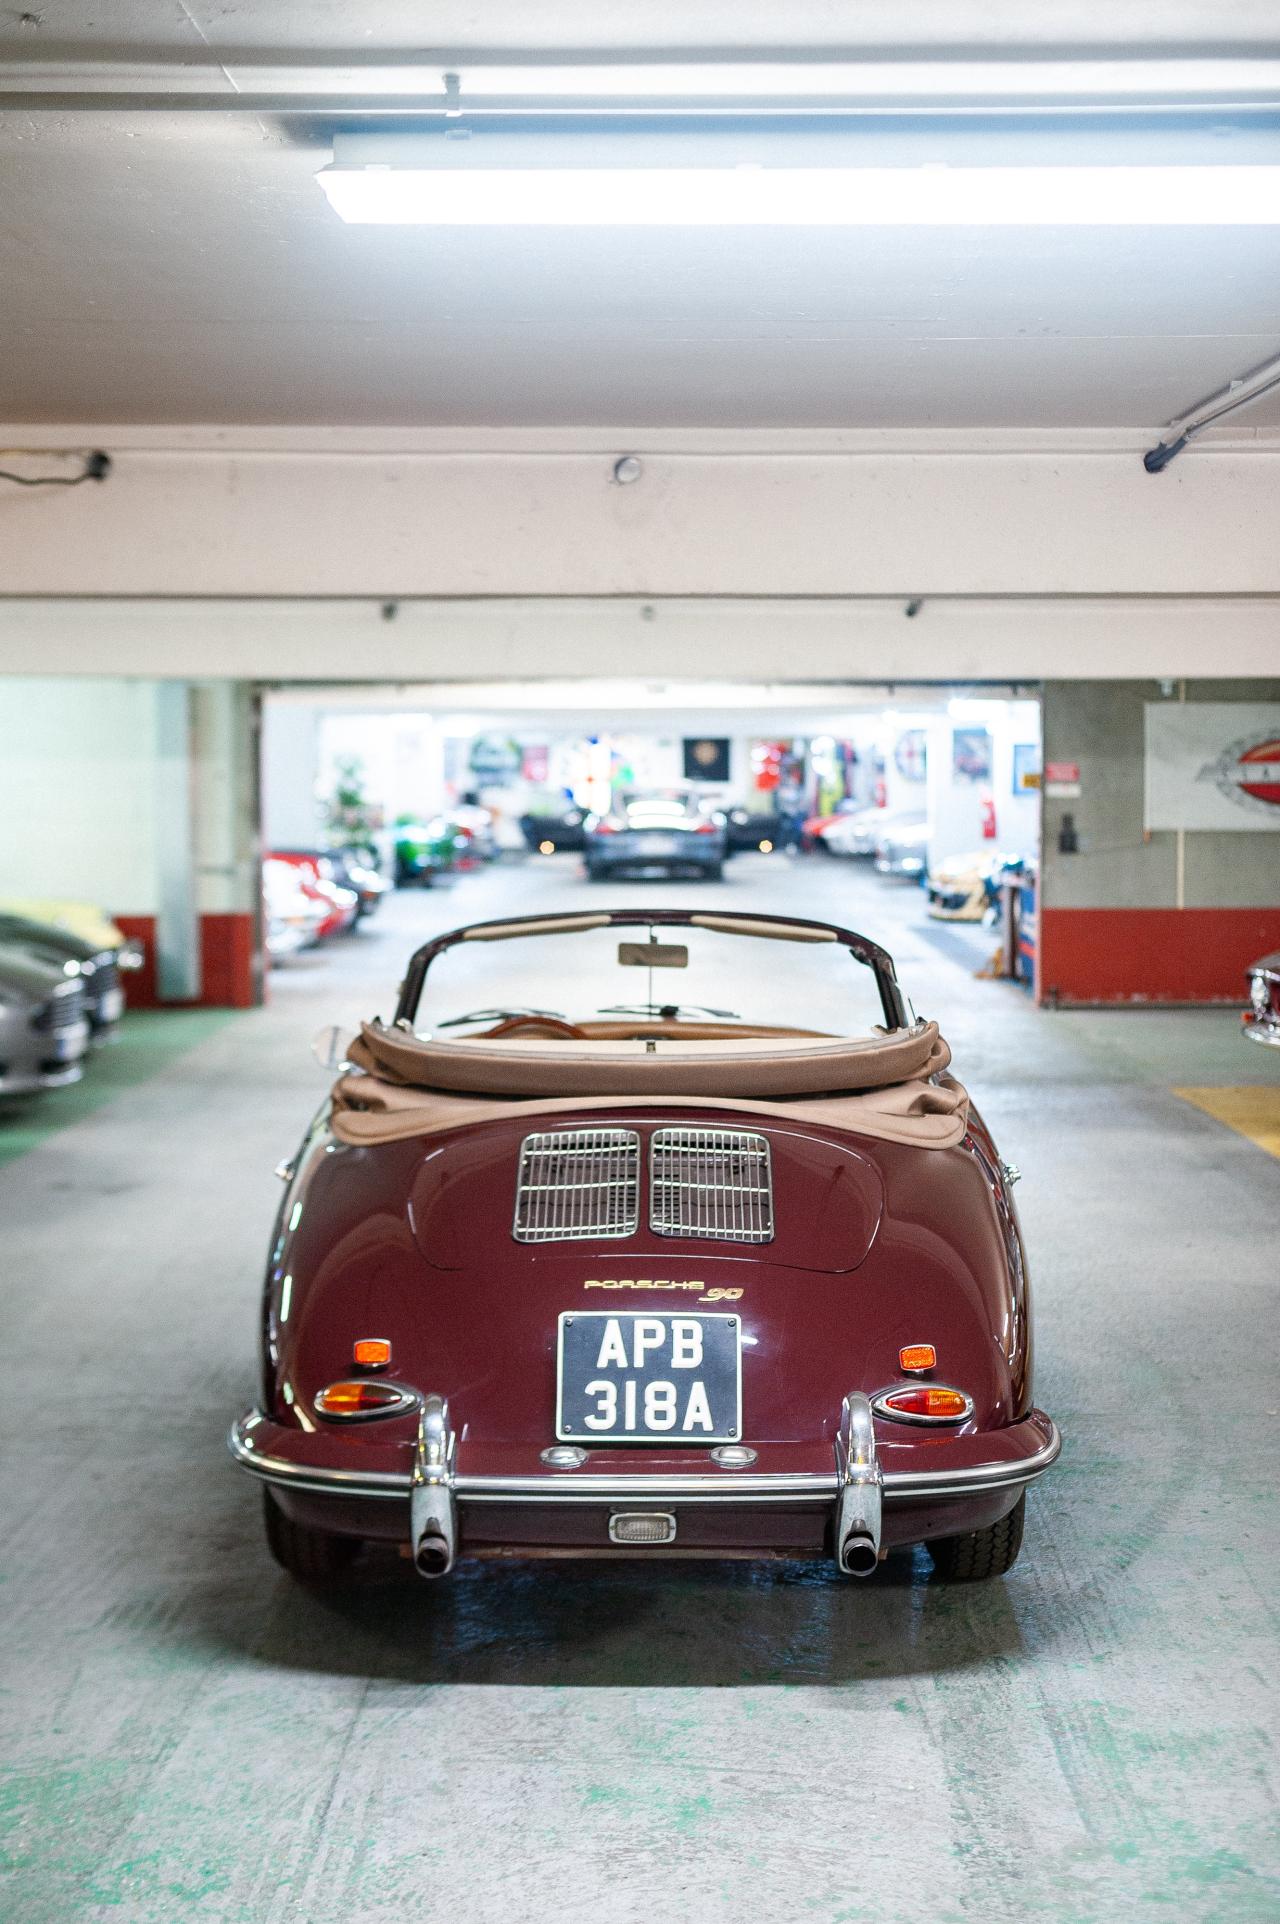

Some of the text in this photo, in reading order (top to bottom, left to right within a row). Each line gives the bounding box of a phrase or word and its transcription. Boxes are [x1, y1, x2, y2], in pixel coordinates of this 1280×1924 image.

[583, 1280, 705, 1290] PORSCHE
[697, 1287, 744, 1302] 90
[596, 1319, 704, 1369] APB
[584, 1380, 714, 1432] 318A
